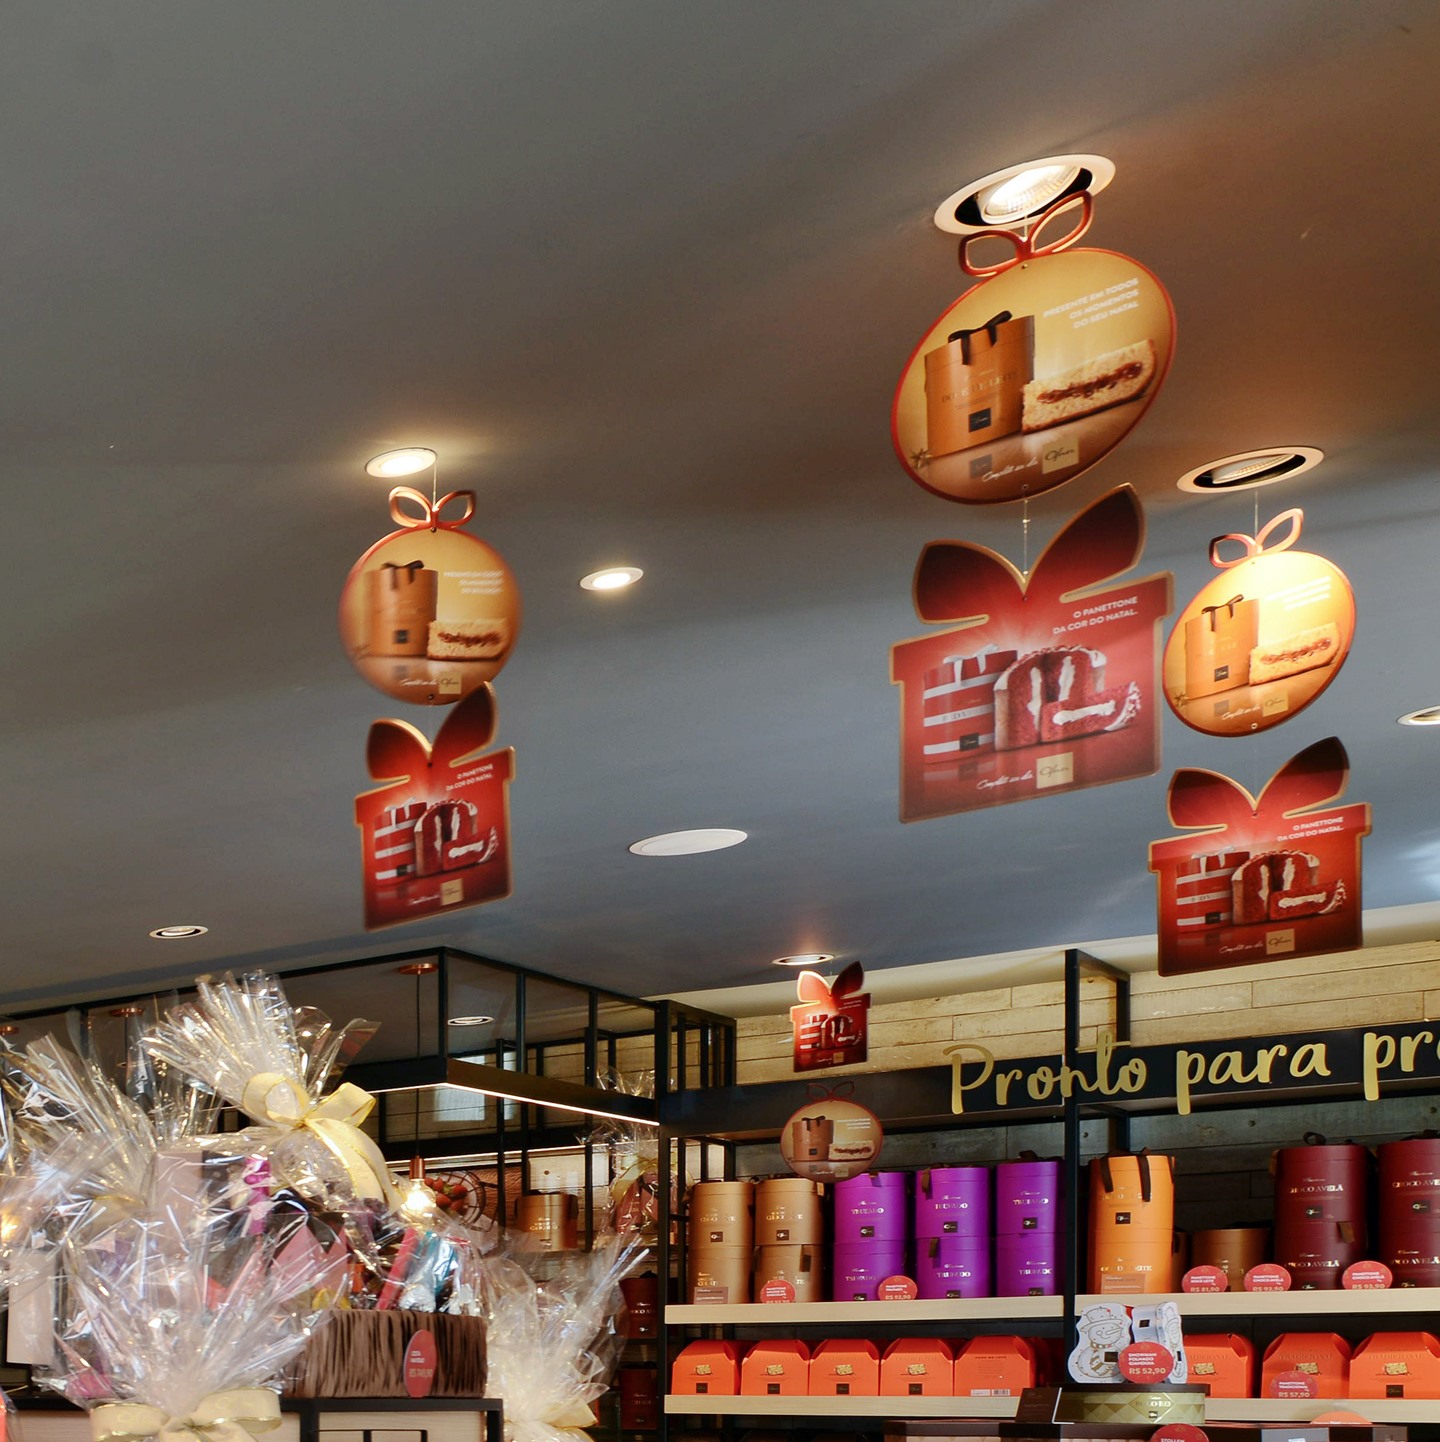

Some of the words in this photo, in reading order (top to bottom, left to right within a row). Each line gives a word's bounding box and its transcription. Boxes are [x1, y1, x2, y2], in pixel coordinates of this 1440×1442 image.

[1043, 296, 1088, 319] PRESENTE
[1090, 291, 1104, 302] EM
[1105, 277, 1140, 297] TODOS
[1069, 309, 1082, 320] OS
[1083, 289, 1140, 316] MOMENTOS
[1073, 320, 1088, 329] DO
[1089, 312, 1107, 326] SEU
[1108, 301, 1140, 320] NATAL
[1073, 610, 1082, 619] O
[1083, 596, 1138, 617] PANETTONE
[1053, 626, 1067, 635] DA
[1067, 620, 1088, 632] COR
[1089, 616, 1104, 626] DO
[1106, 608, 1139, 622] NATAL.
[462, 763, 494, 778] PANETTONE
[1289, 831, 1305, 841] COR
[1306, 829, 1318, 837] DO
[1318, 825, 1345, 836] NATAL.
[1300, 816, 1344, 830] PANETTONE
[942, 1032, 1147, 1115] Pronto
[1175, 1042, 1331, 1116] para
[1363, 1030, 1440, 1101] pr
[1129, 1367, 1141, 1375] R$
[1142, 1367, 1166, 1375] 52,90
